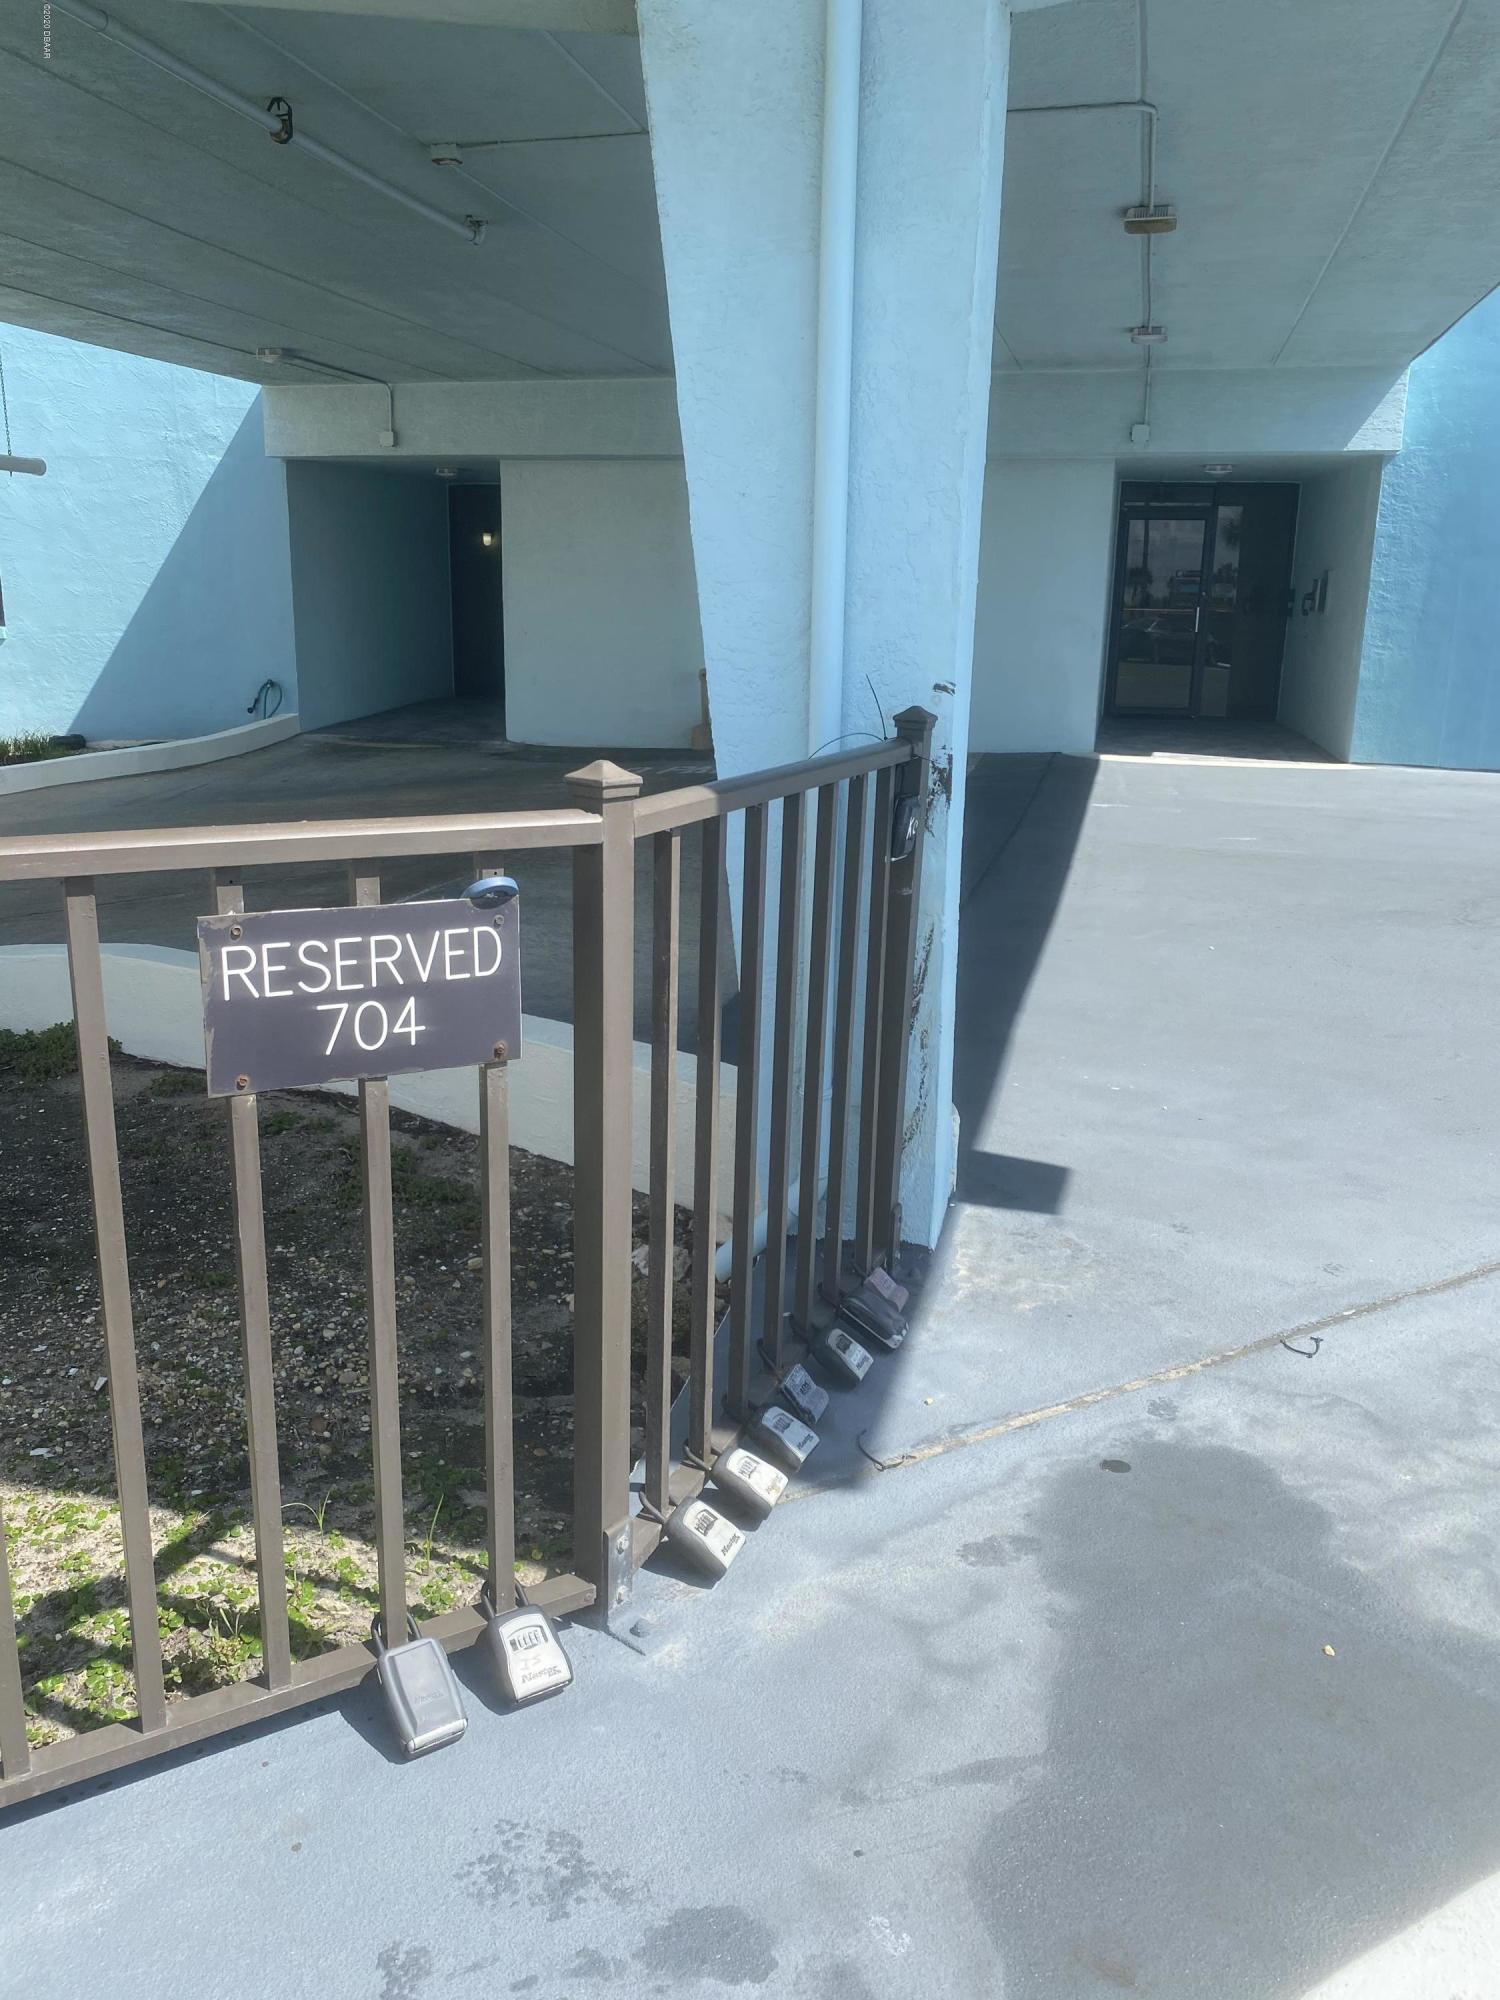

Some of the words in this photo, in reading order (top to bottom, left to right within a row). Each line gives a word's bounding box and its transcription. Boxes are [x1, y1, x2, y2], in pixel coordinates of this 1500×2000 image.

[220, 925, 502, 1001] RESERVED
[316, 996, 426, 1056] 704
[521, 1665, 558, 1683] Master
